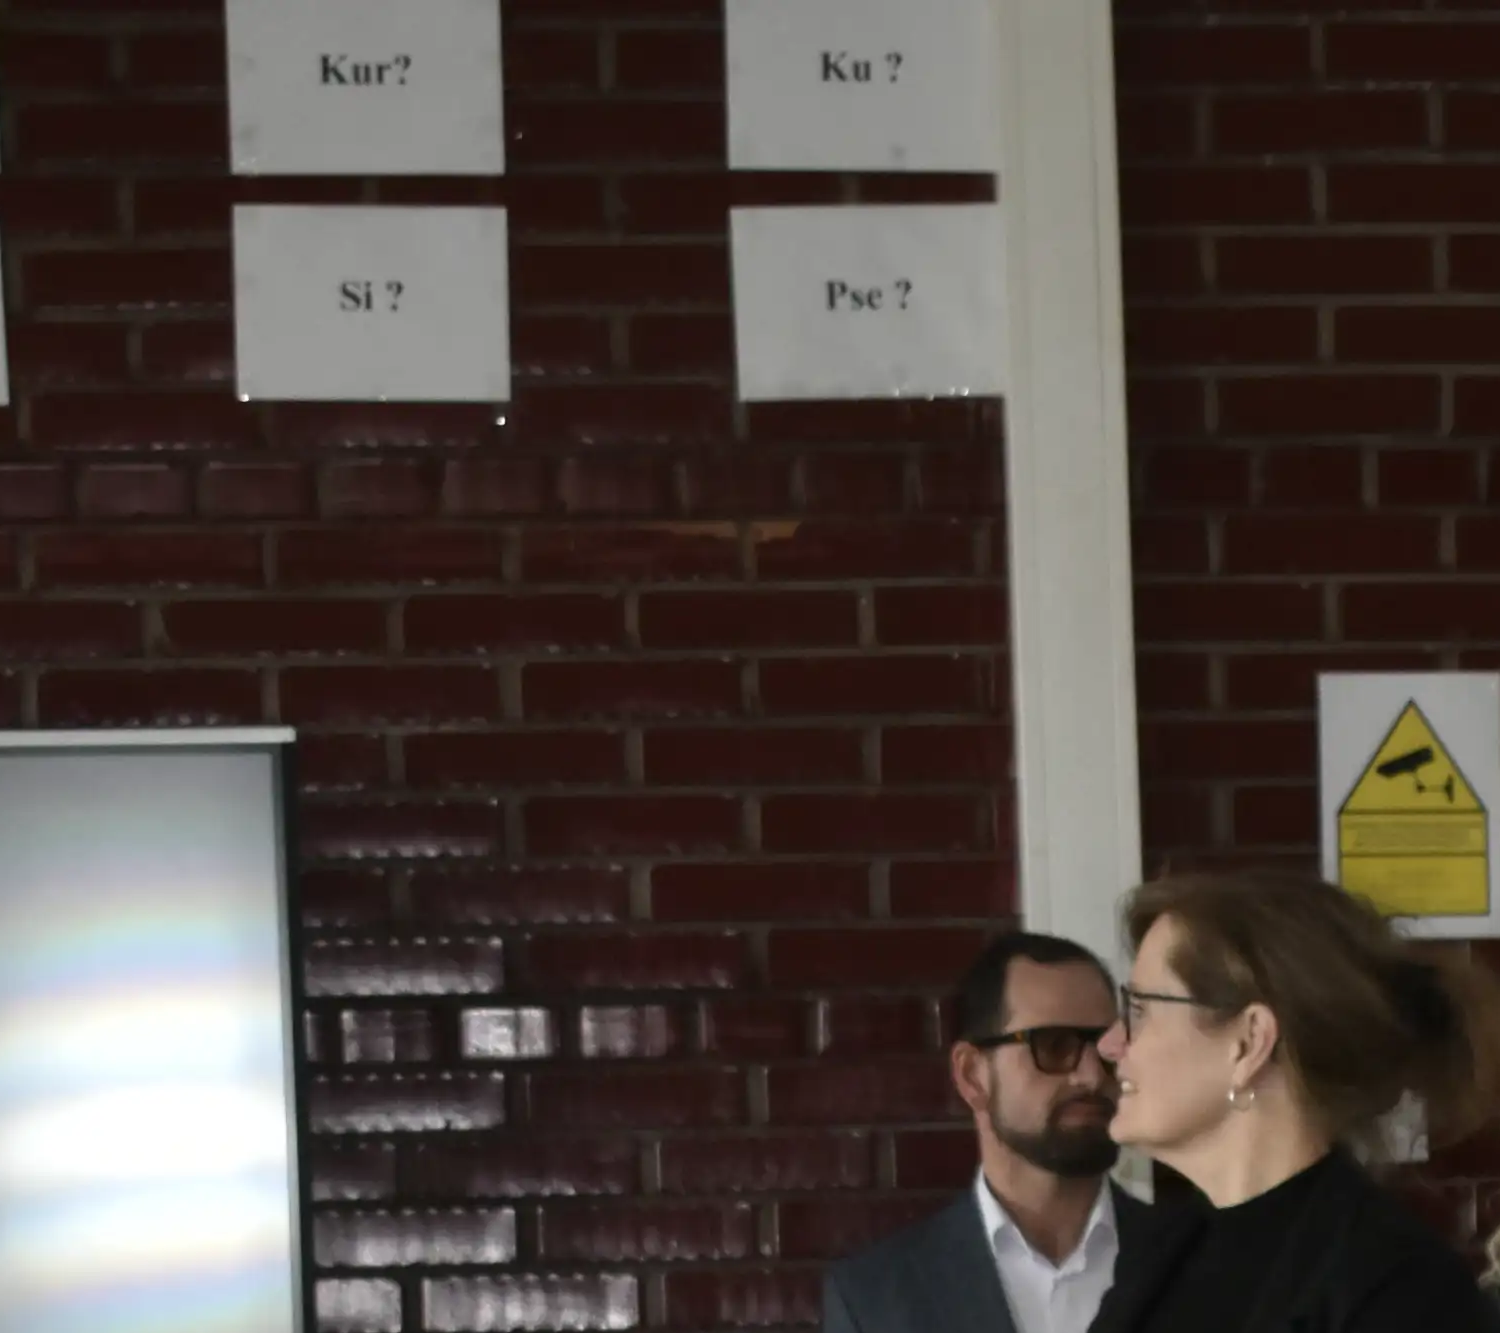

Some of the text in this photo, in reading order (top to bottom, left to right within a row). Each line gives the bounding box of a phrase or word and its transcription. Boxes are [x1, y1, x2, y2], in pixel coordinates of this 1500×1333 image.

[319, 53, 413, 87] Kur?
[820, 51, 903, 84] Ku ?
[339, 280, 405, 312] Si ?
[825, 279, 913, 313] Pse ?
